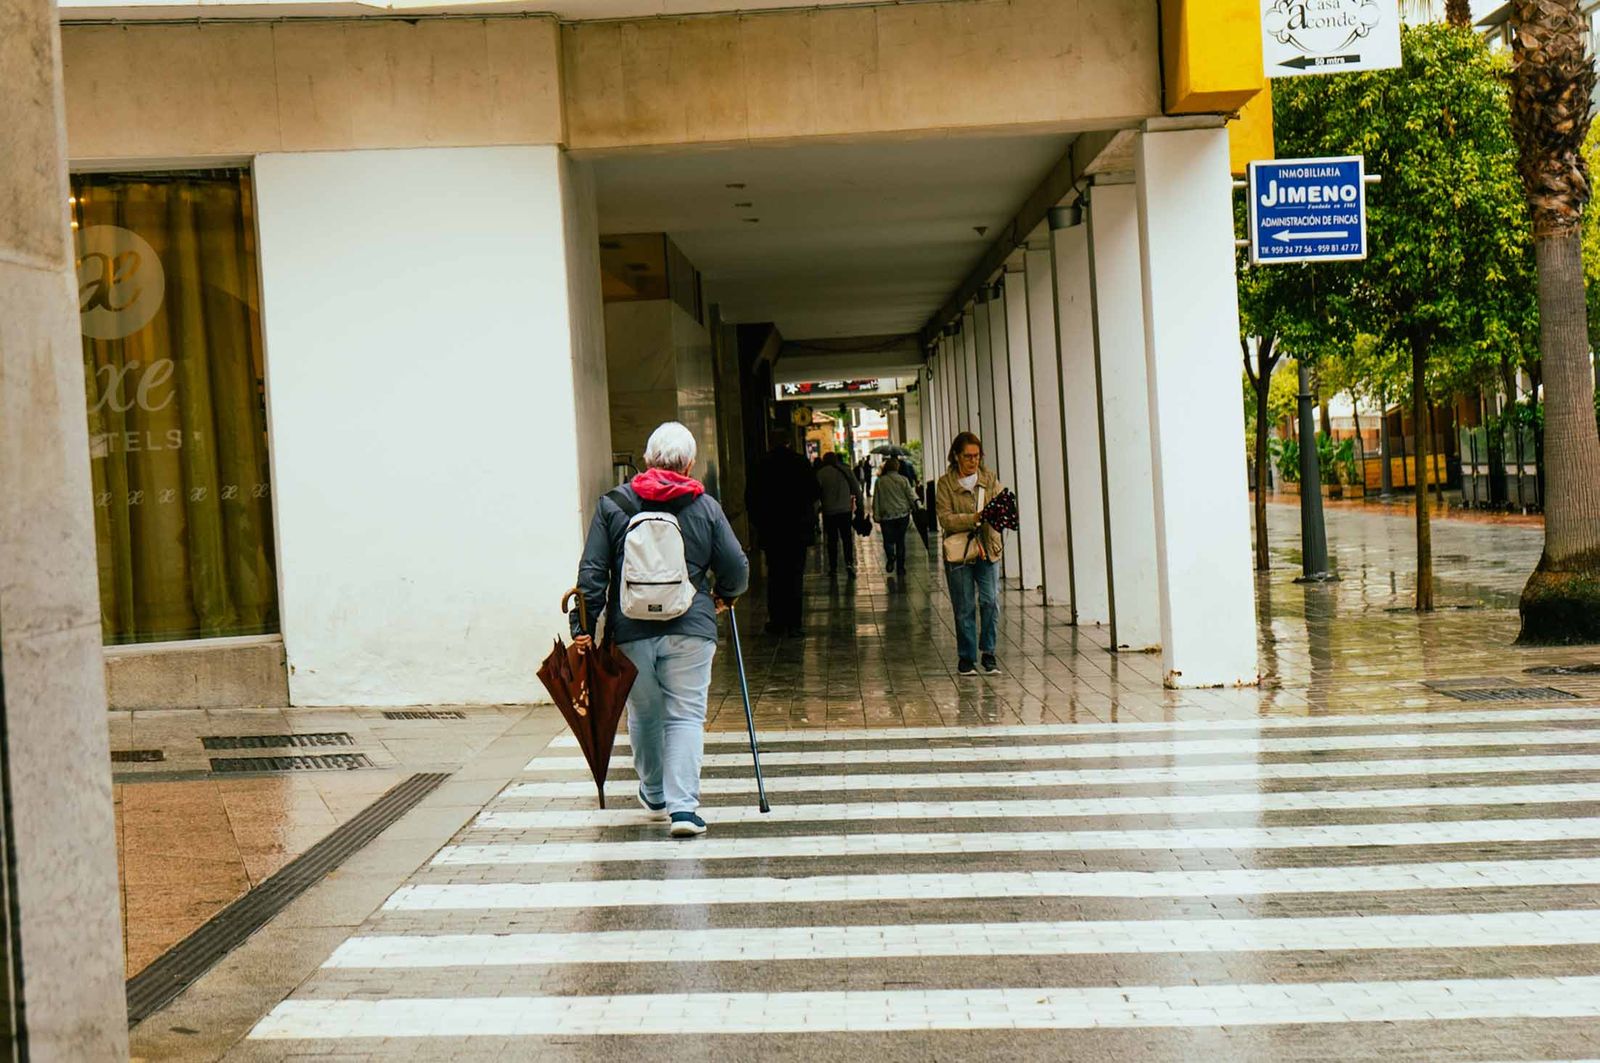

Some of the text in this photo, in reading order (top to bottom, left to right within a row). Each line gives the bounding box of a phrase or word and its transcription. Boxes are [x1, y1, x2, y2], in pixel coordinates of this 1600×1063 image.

[1278, 167, 1341, 179] INMOBILIARIA
[1260, 179, 1358, 207] JIMENO
[1261, 213, 1359, 228] ADMINISTRACIÓN DE FINCAS
[1271, 246, 1284, 254] 959
[1285, 246, 1293, 254] 24
[1294, 245, 1303, 253] 77
[1303, 245, 1312, 253] 56
[1317, 244, 1330, 253] 959
[1350, 243, 1358, 251] 77
[87, 358, 176, 412] xe
[102, 429, 183, 453] TELS
